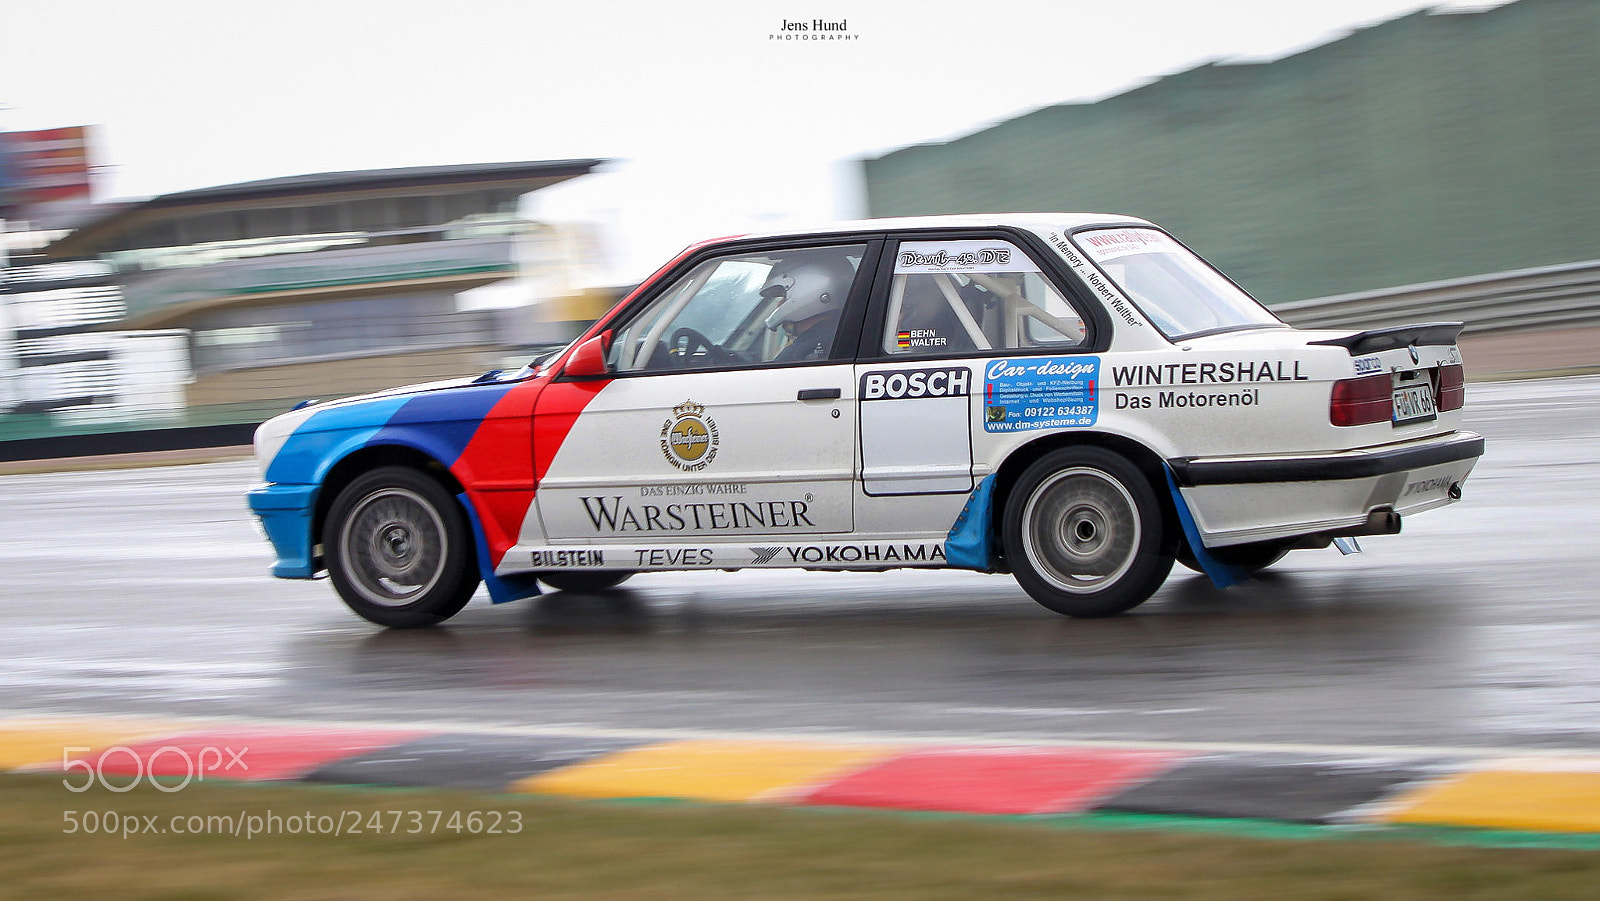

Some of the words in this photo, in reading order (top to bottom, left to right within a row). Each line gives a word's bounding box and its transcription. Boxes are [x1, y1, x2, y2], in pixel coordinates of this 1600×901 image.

[1087, 272, 1114, 301] Norbert
[910, 329, 936, 338] BEHN
[910, 337, 947, 347] WALTER
[987, 360, 1095, 380] Car-design
[1112, 360, 1309, 386] WINTERSHALL
[865, 370, 969, 399] BOSCH
[1115, 392, 1152, 410] Das
[1159, 389, 1259, 409] Motorenöl
[1024, 407, 1055, 417] 09122
[1057, 405, 1095, 416] 634387
[987, 417, 1092, 431] www.dm-systeme.de
[705, 447, 719, 464] DEN
[640, 485, 664, 497] DAS
[666, 484, 704, 496] EINZIG
[706, 483, 749, 495] WAHRE
[578, 496, 817, 532] WARSTEINER
[531, 550, 605, 567] BILSTEIN
[634, 549, 714, 566] TEVES
[787, 544, 946, 562] YOKOHAMA
